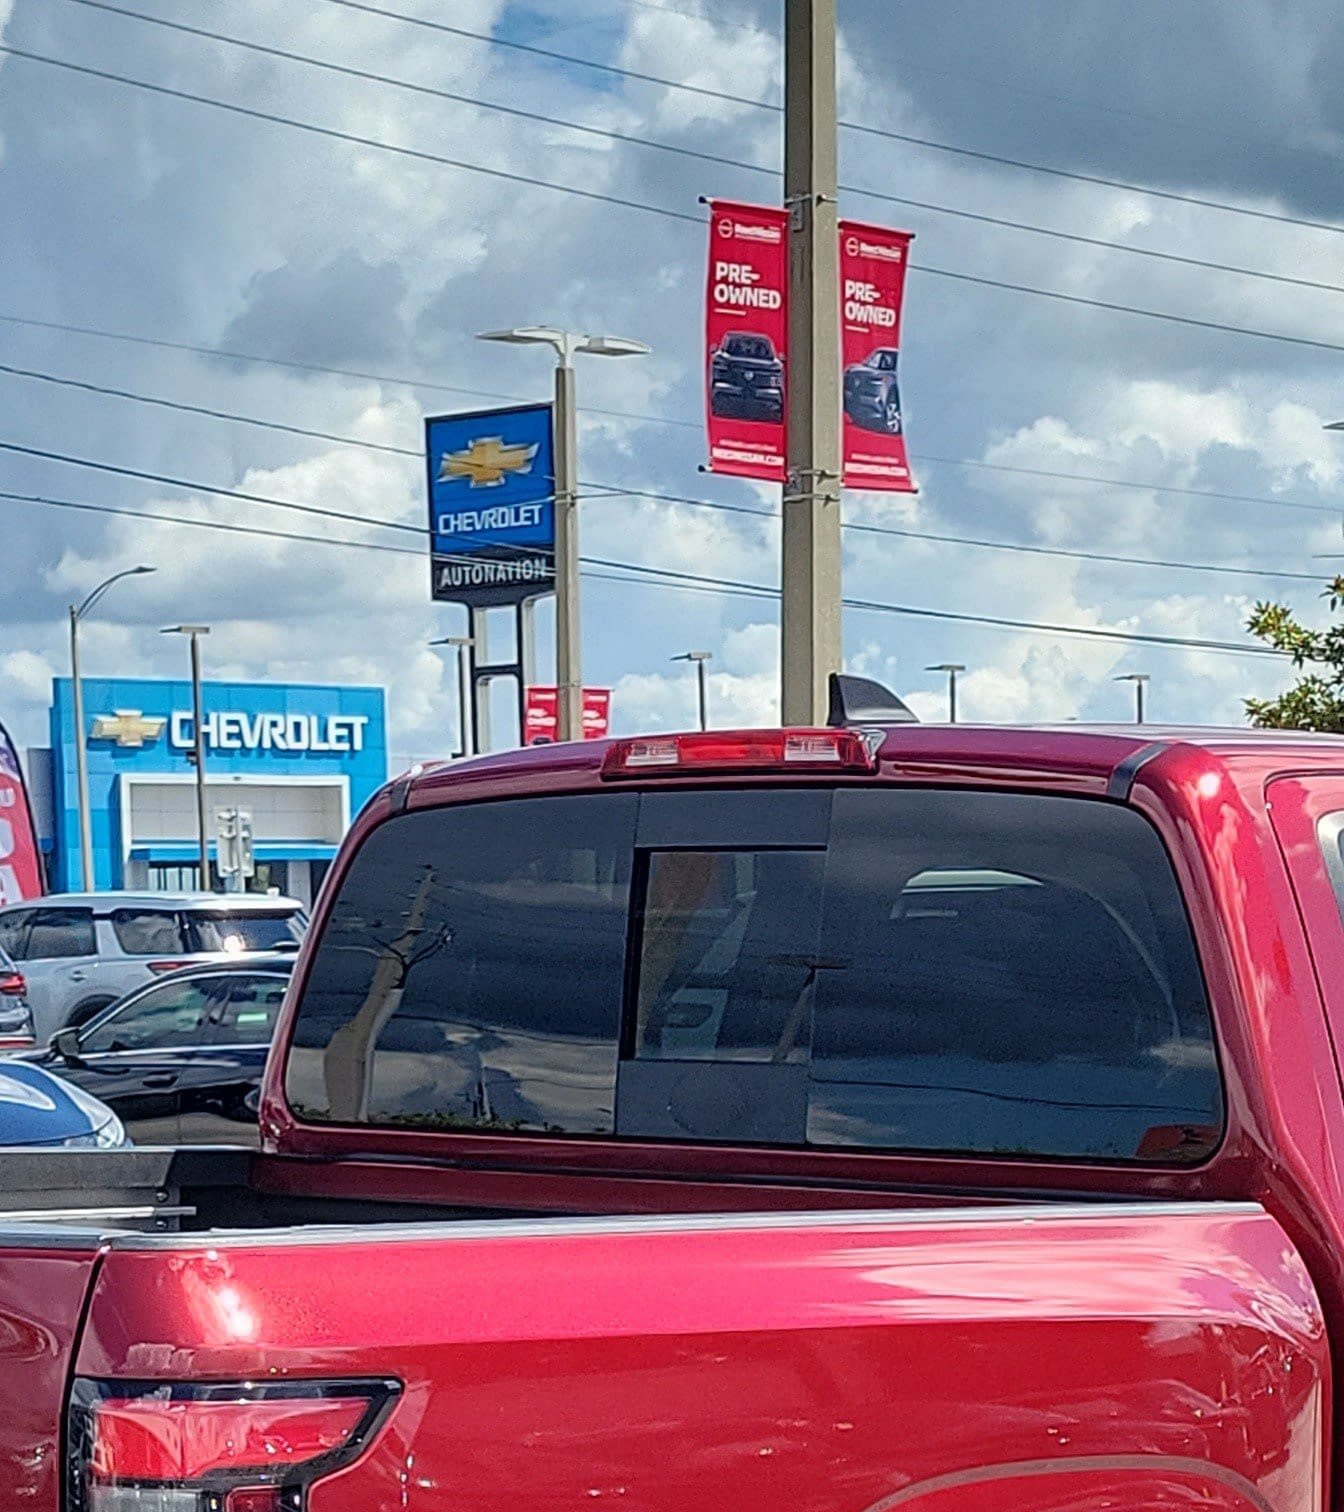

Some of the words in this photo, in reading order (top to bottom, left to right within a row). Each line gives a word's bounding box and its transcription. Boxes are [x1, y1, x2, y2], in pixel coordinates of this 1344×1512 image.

[714, 261, 760, 285] PRE-
[713, 283, 782, 310] OWNED
[844, 279, 881, 304] PRE-
[844, 302, 896, 328] OWNED
[438, 504, 543, 535] CHEVROLET
[440, 556, 549, 588] AUTONATION
[171, 710, 369, 751] CHEVROLET
